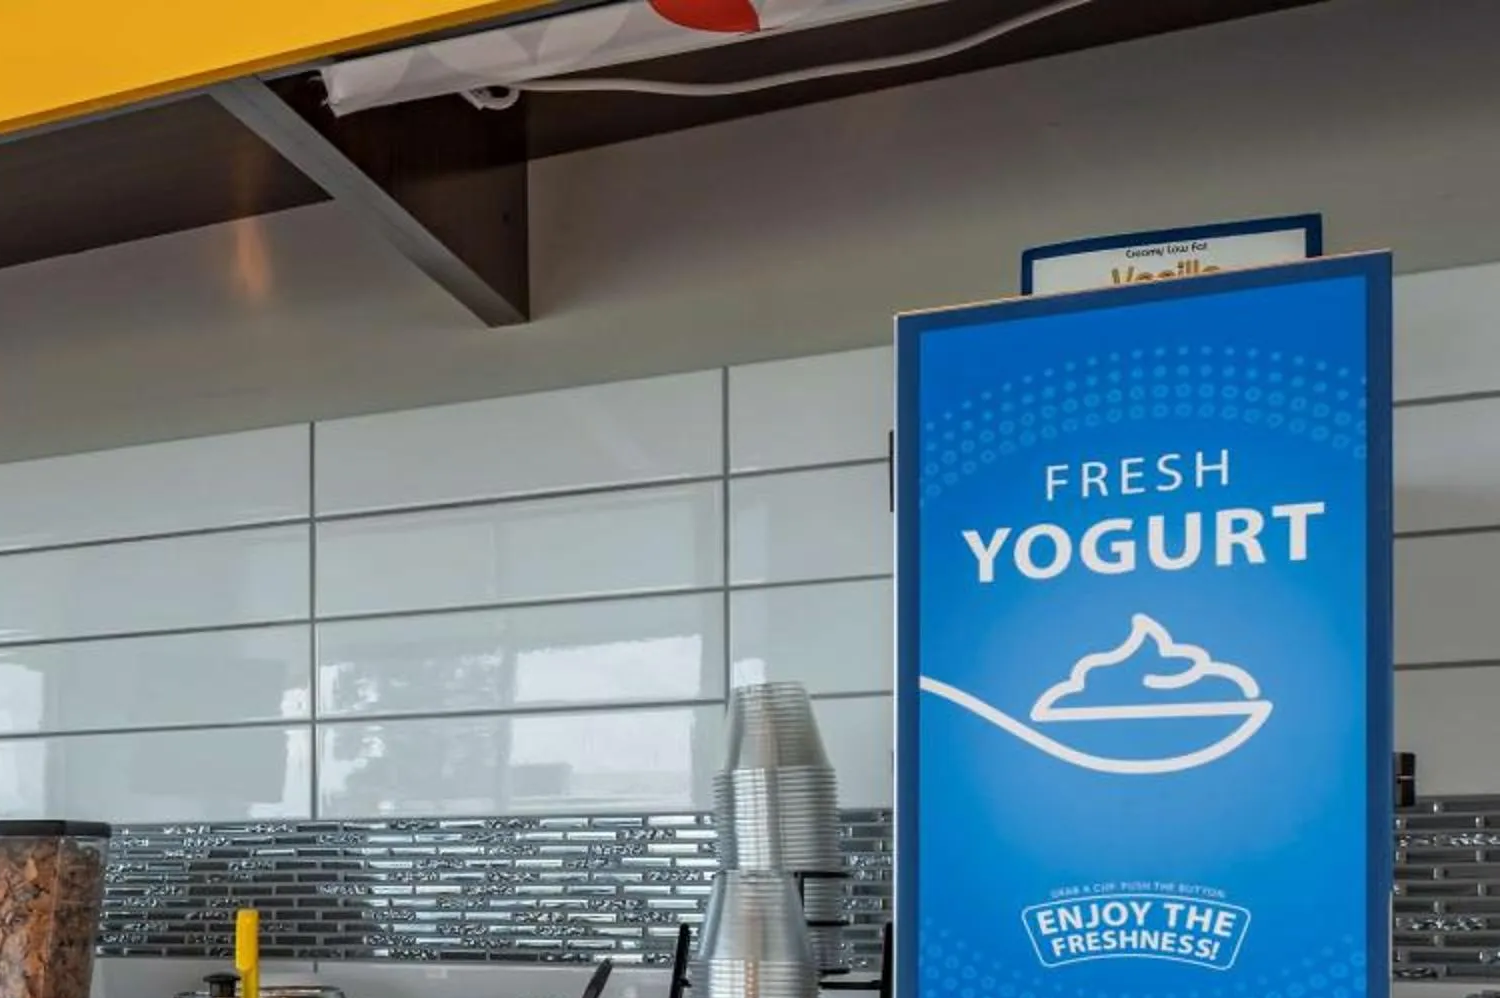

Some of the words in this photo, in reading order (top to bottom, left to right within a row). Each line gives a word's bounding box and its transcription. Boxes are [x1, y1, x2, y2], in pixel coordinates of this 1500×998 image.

[1047, 449, 1229, 501] FRESH
[962, 502, 1325, 583] YOGURT
[1036, 901, 1153, 936] ENJOY
[1163, 903, 1238, 937] THE
[1051, 930, 1221, 960] FRESHNESS!
